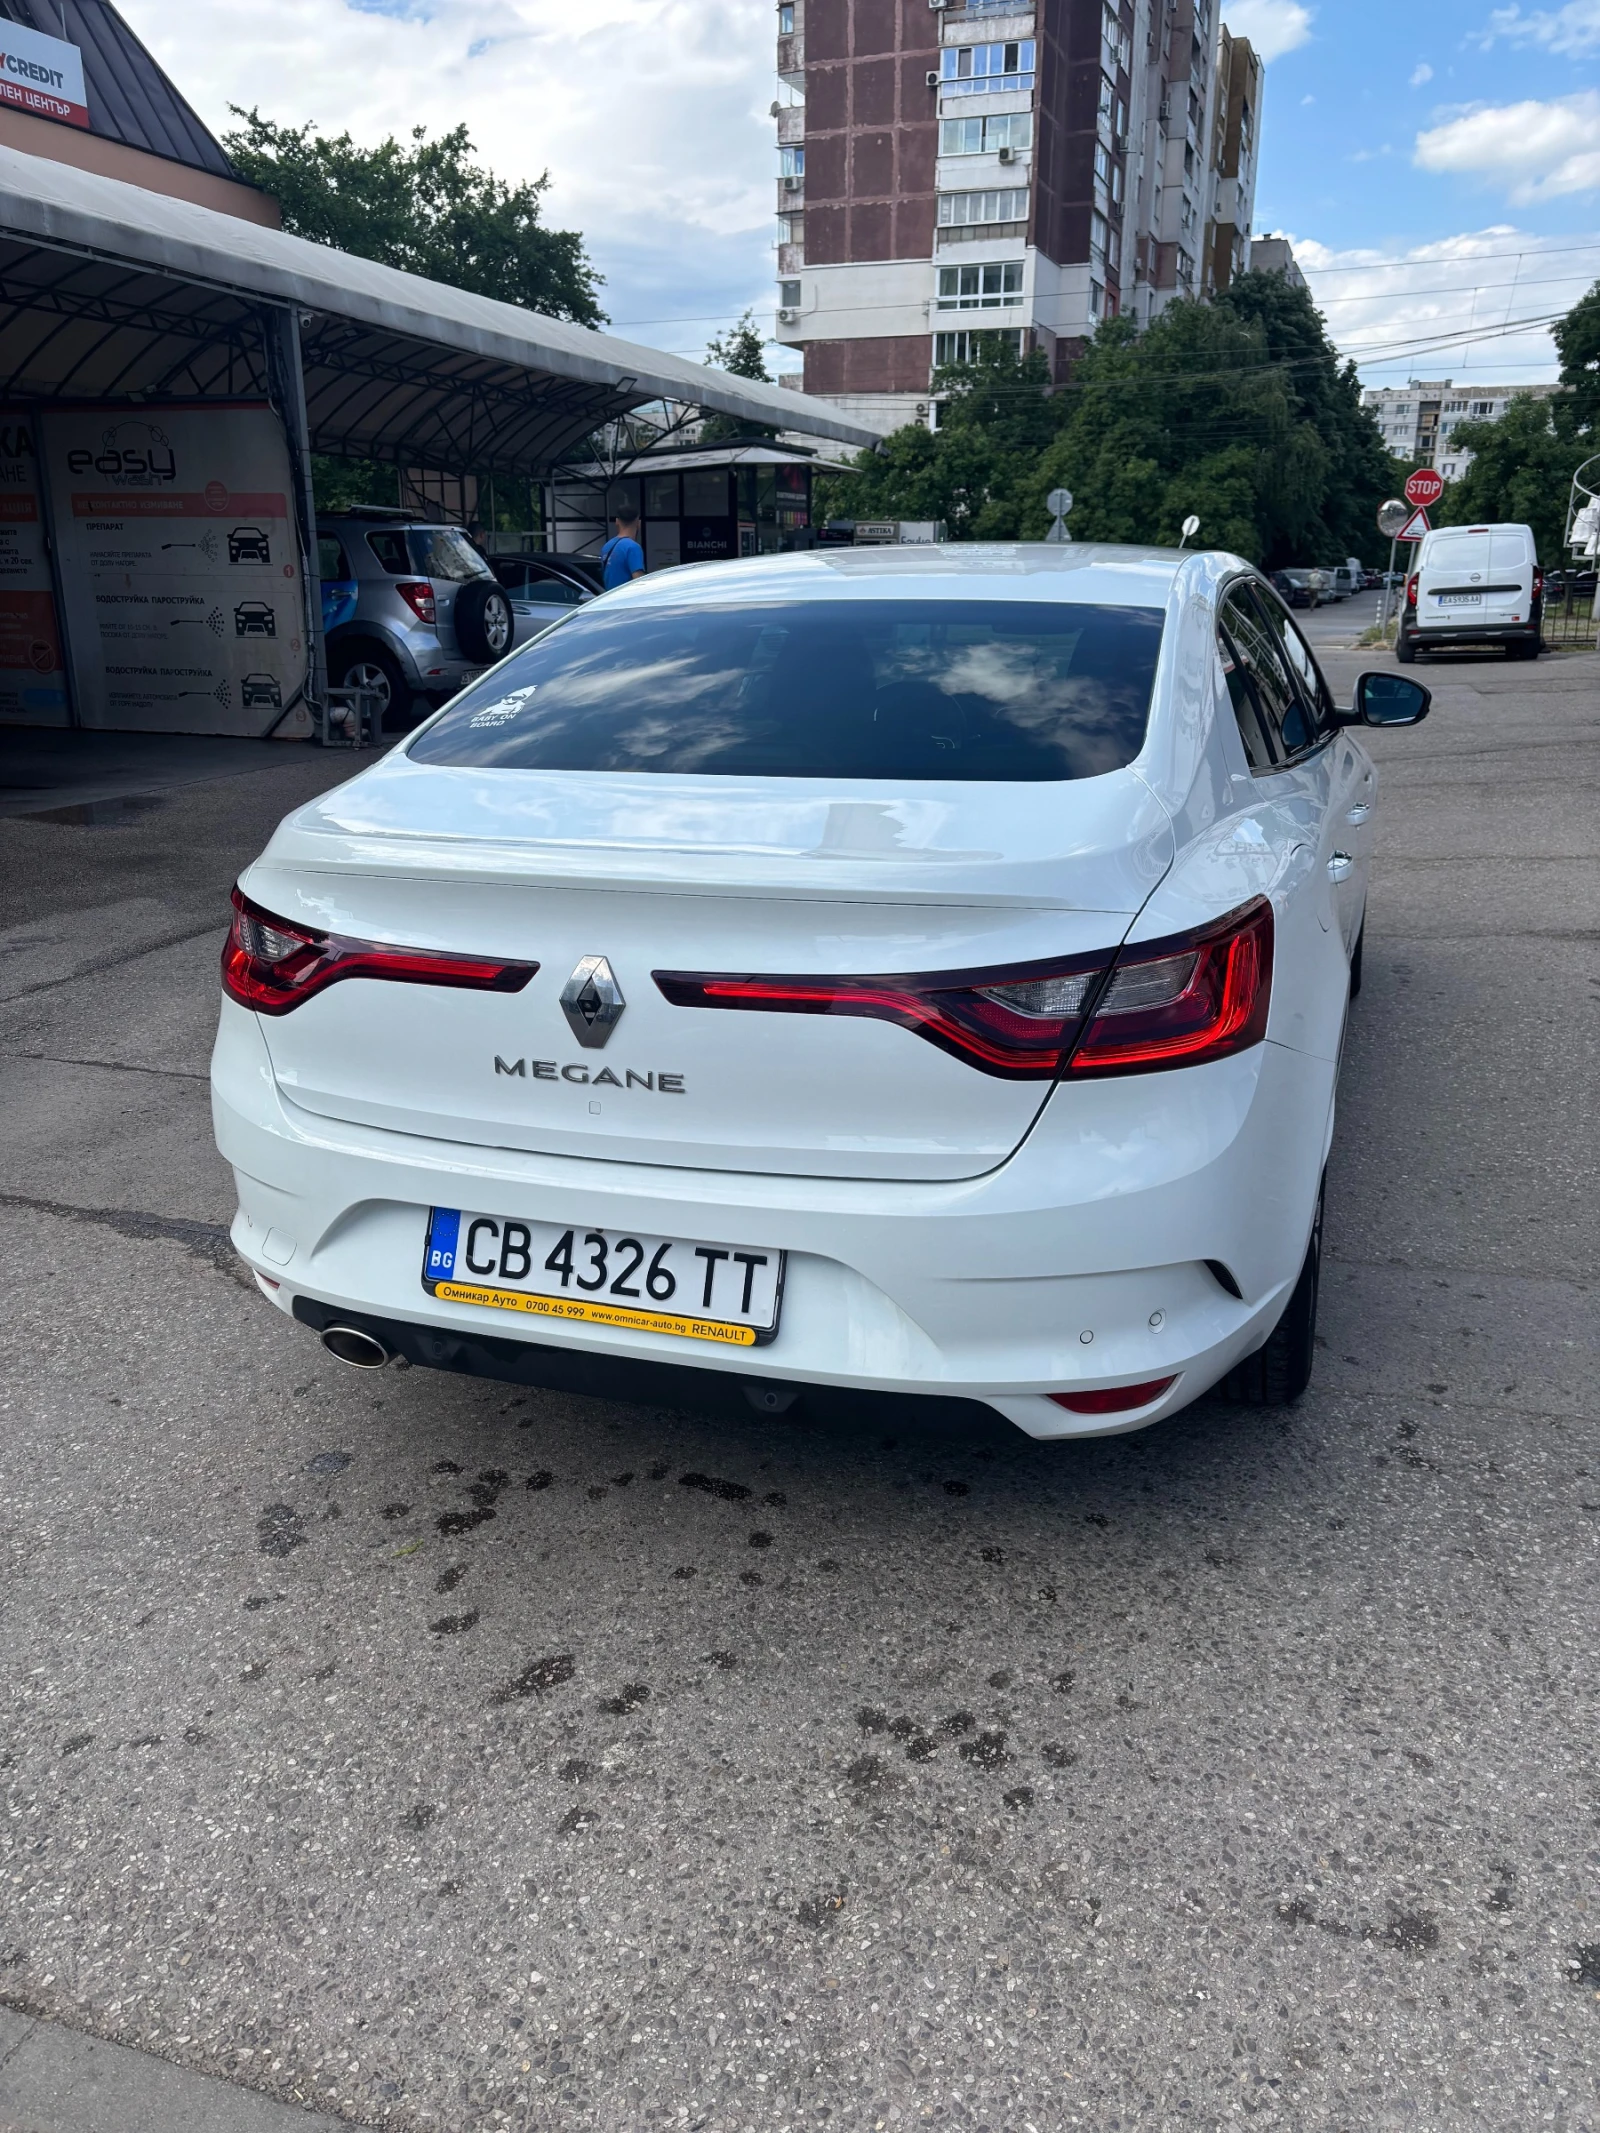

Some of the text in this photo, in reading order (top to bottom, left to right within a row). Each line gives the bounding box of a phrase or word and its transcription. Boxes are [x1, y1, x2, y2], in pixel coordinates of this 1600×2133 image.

[25, 91, 70, 116] ЦЕНТЪР
[67, 448, 176, 480] easy
[112, 473, 162, 486] wash
[1408, 481, 1440, 495] STOP
[0, 501, 32, 515] АЦИЯ
[140, 500, 183, 509] ИЗМИВАНЕ
[86, 523, 124, 531] ПРЕПАРАТ
[687, 541, 727, 549] BIANCHI
[96, 594, 205, 605] ВОДОСТРУЙКА ПАРОСТРУЙКА
[106, 666, 157, 675] ВОДОСТРУЙКА
[494, 1054, 686, 1093] MEGANE
[431, 1250, 453, 1268] BG
[465, 1218, 768, 1313] CB 4326 TT
[443, 1287, 748, 1341] Омникар Ауто 0700 45 999 www.omnicar-auto.bg RENAULT
